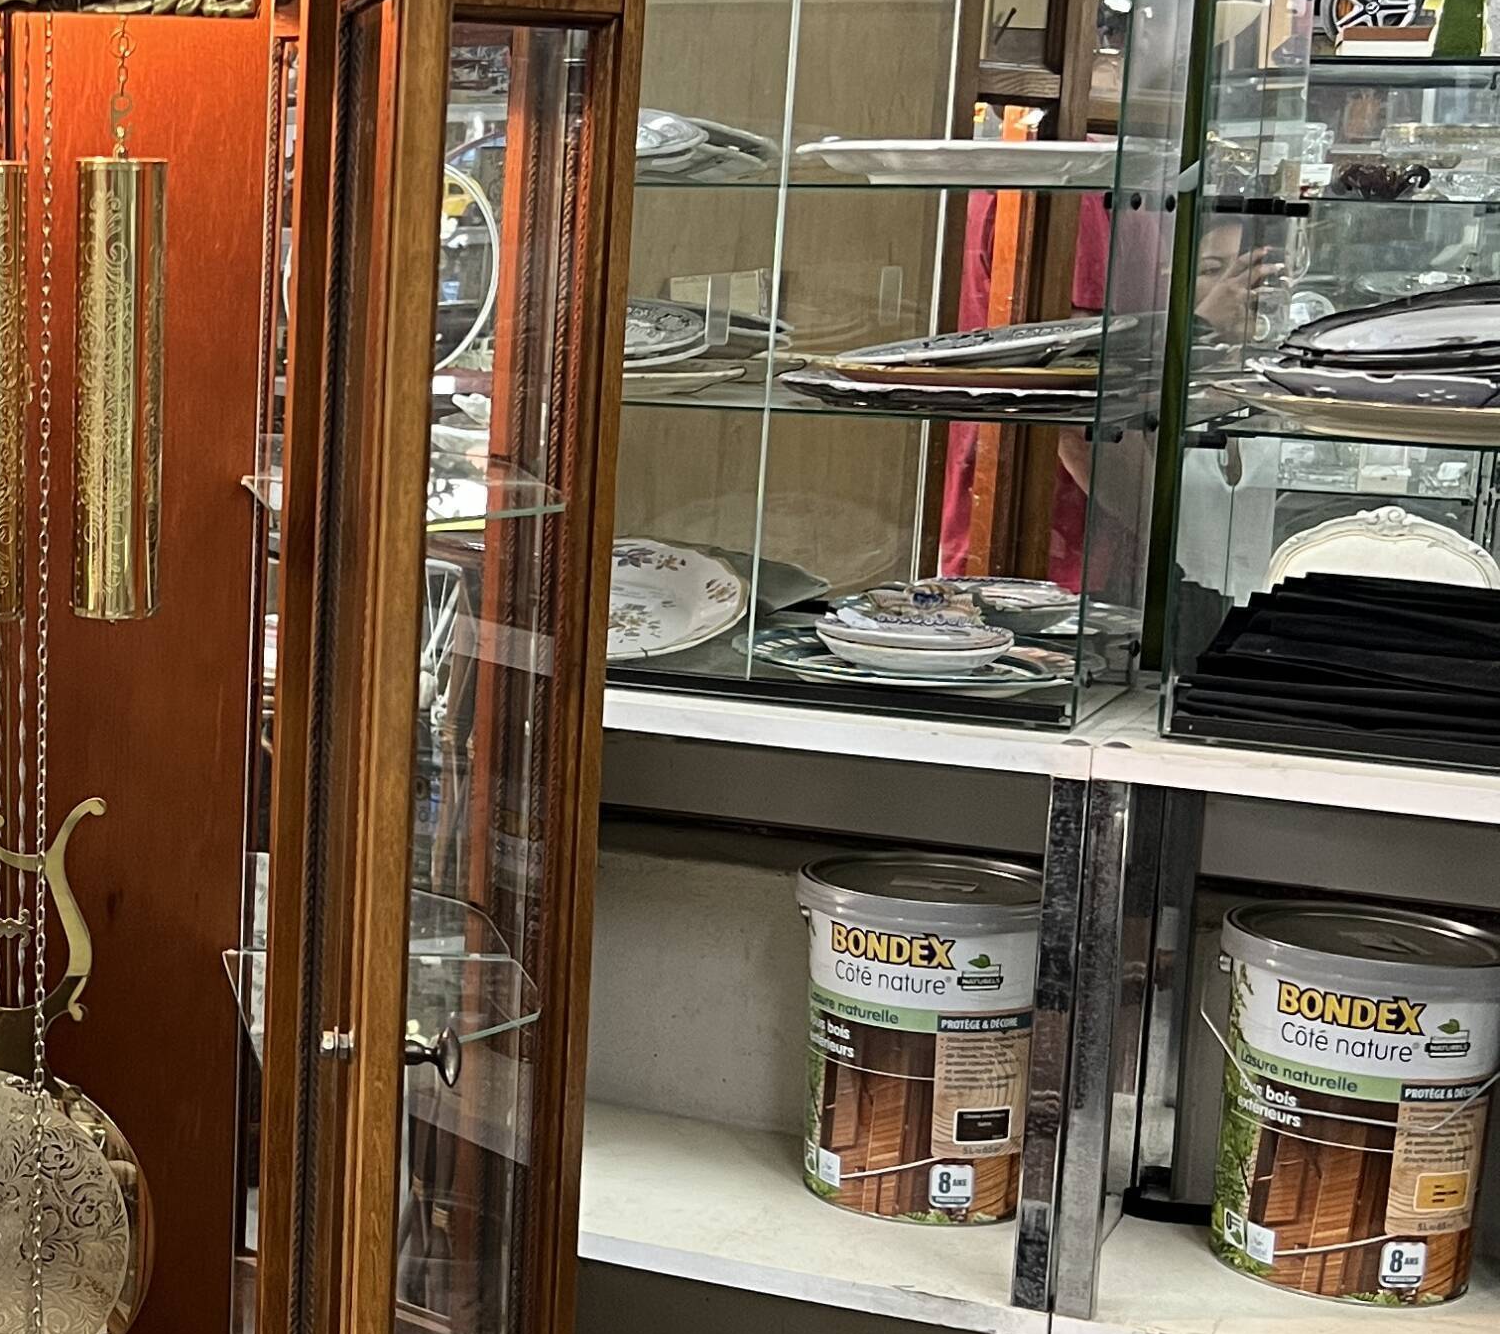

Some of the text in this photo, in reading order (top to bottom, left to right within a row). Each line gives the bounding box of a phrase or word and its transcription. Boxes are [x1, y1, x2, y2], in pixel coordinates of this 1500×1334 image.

[830, 920, 956, 970] BONDEX
[835, 960, 872, 985] Côté
[837, 1002, 899, 1025] naturelle
[1277, 979, 1427, 1036] BONDEX
[826, 1018, 851, 1040] bois
[982, 1021, 989, 1029] &
[1281, 1022, 1329, 1051] Côté
[1240, 1044, 1358, 1094] Lasure naturelle
[1265, 1084, 1298, 1108] bois
[938, 1171, 951, 1193] 8
[1389, 1249, 1404, 1273] 8
